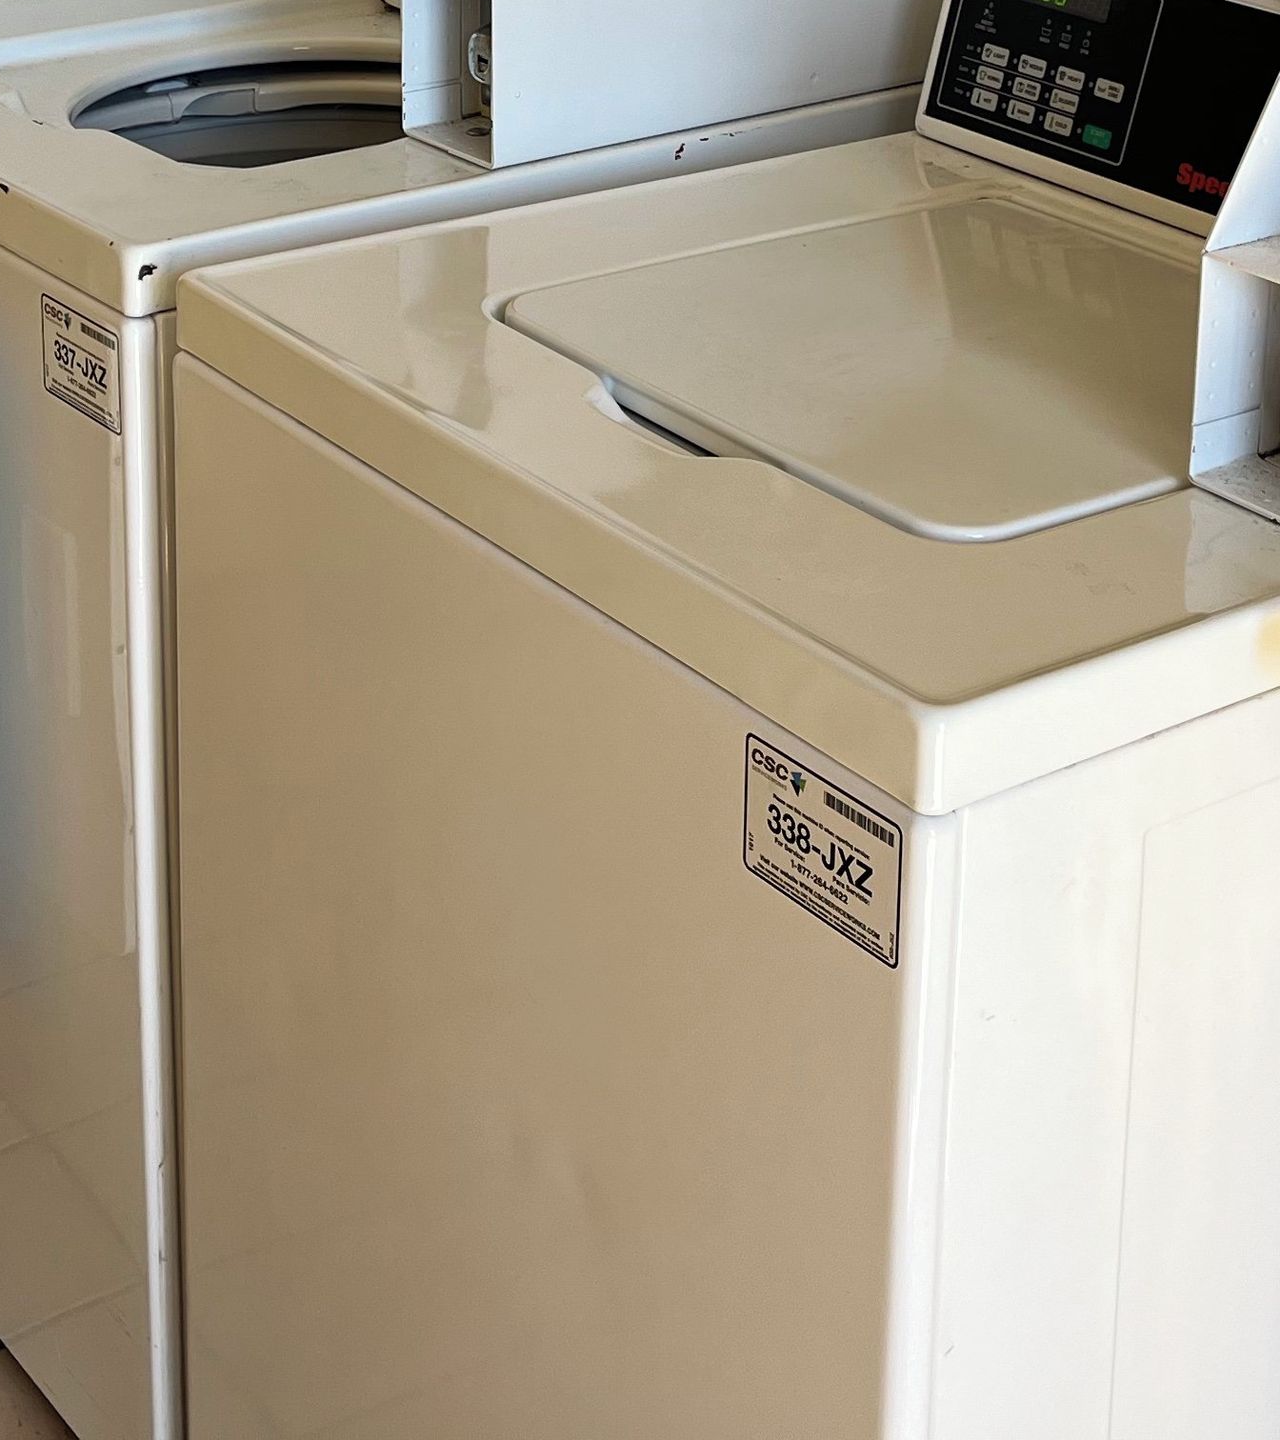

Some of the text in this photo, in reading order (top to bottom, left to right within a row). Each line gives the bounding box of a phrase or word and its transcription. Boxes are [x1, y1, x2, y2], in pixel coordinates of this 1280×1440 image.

[44, 303, 63, 321] CSC
[54, 340, 107, 389] 337-JXZ
[751, 748, 789, 781] CSC
[767, 804, 873, 898] 338-JXZ
